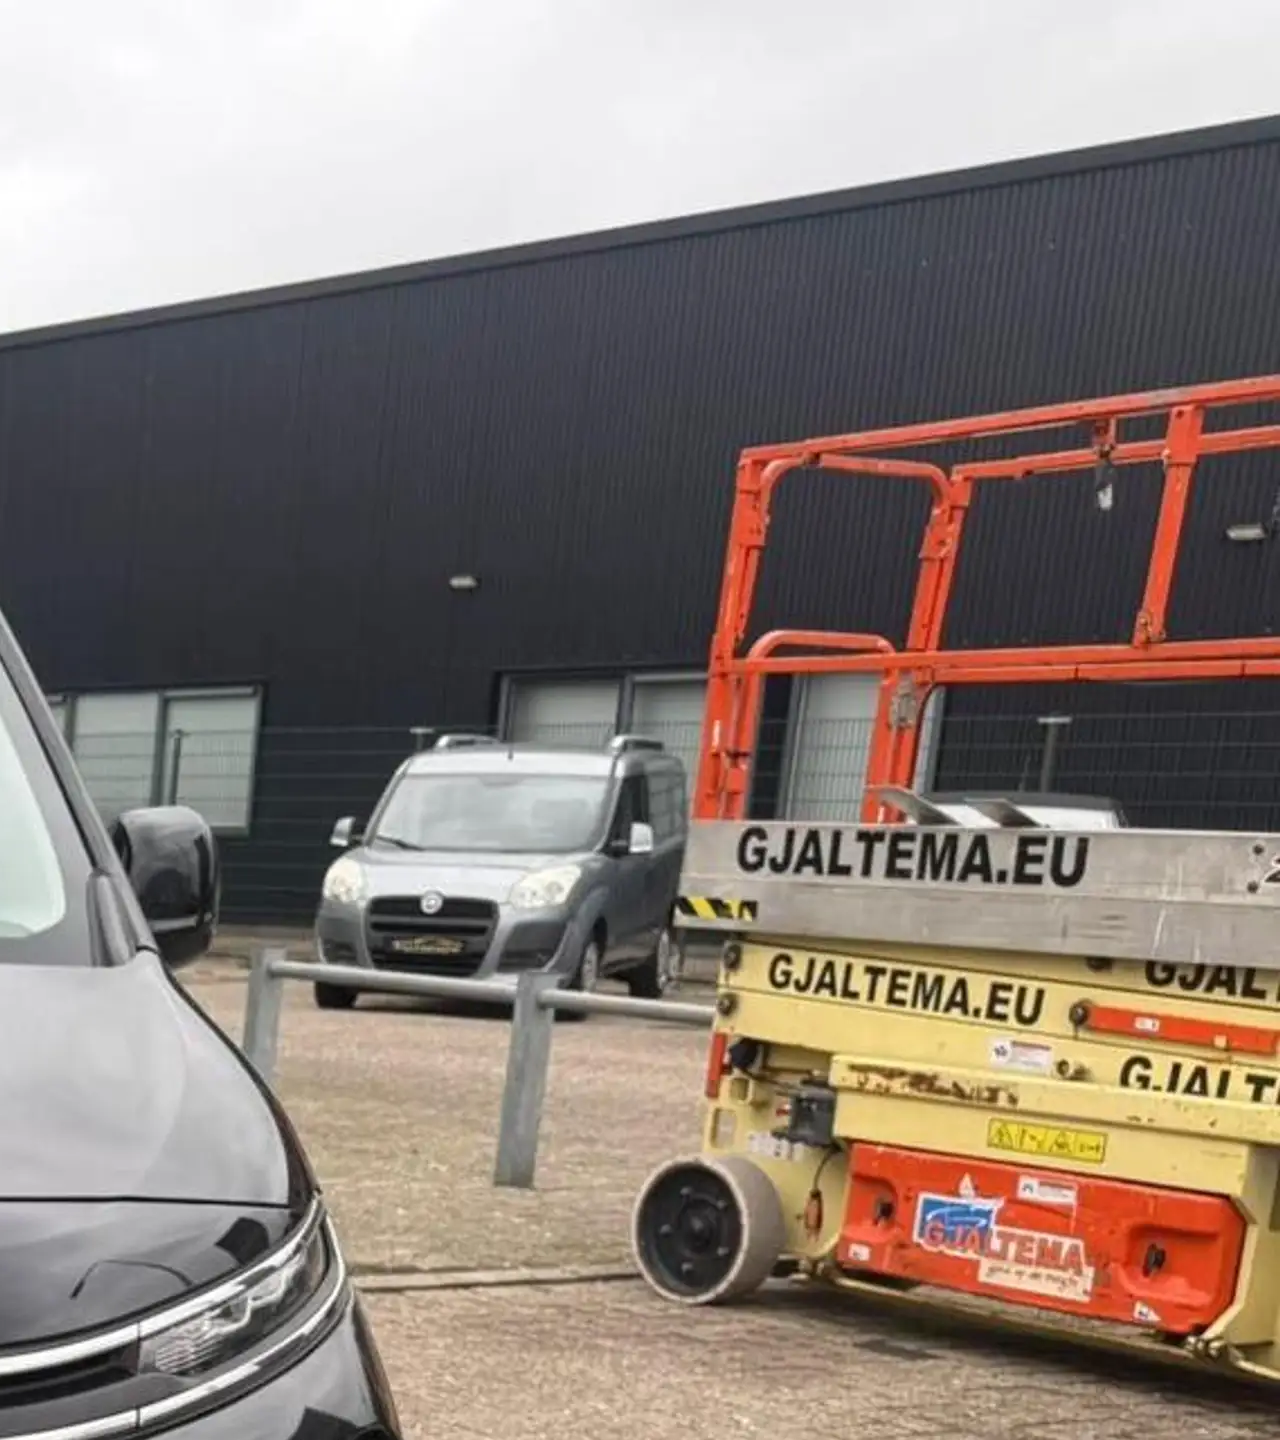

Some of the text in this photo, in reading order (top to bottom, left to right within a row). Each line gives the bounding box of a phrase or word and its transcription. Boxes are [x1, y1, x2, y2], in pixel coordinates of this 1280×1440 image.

[736, 826, 1091, 888] GJALTEMA.EU
[767, 952, 1046, 1026] GJALTEMA.EU
[1145, 959, 1280, 1003] GJAL
[1119, 1055, 1280, 1104] GJALT
